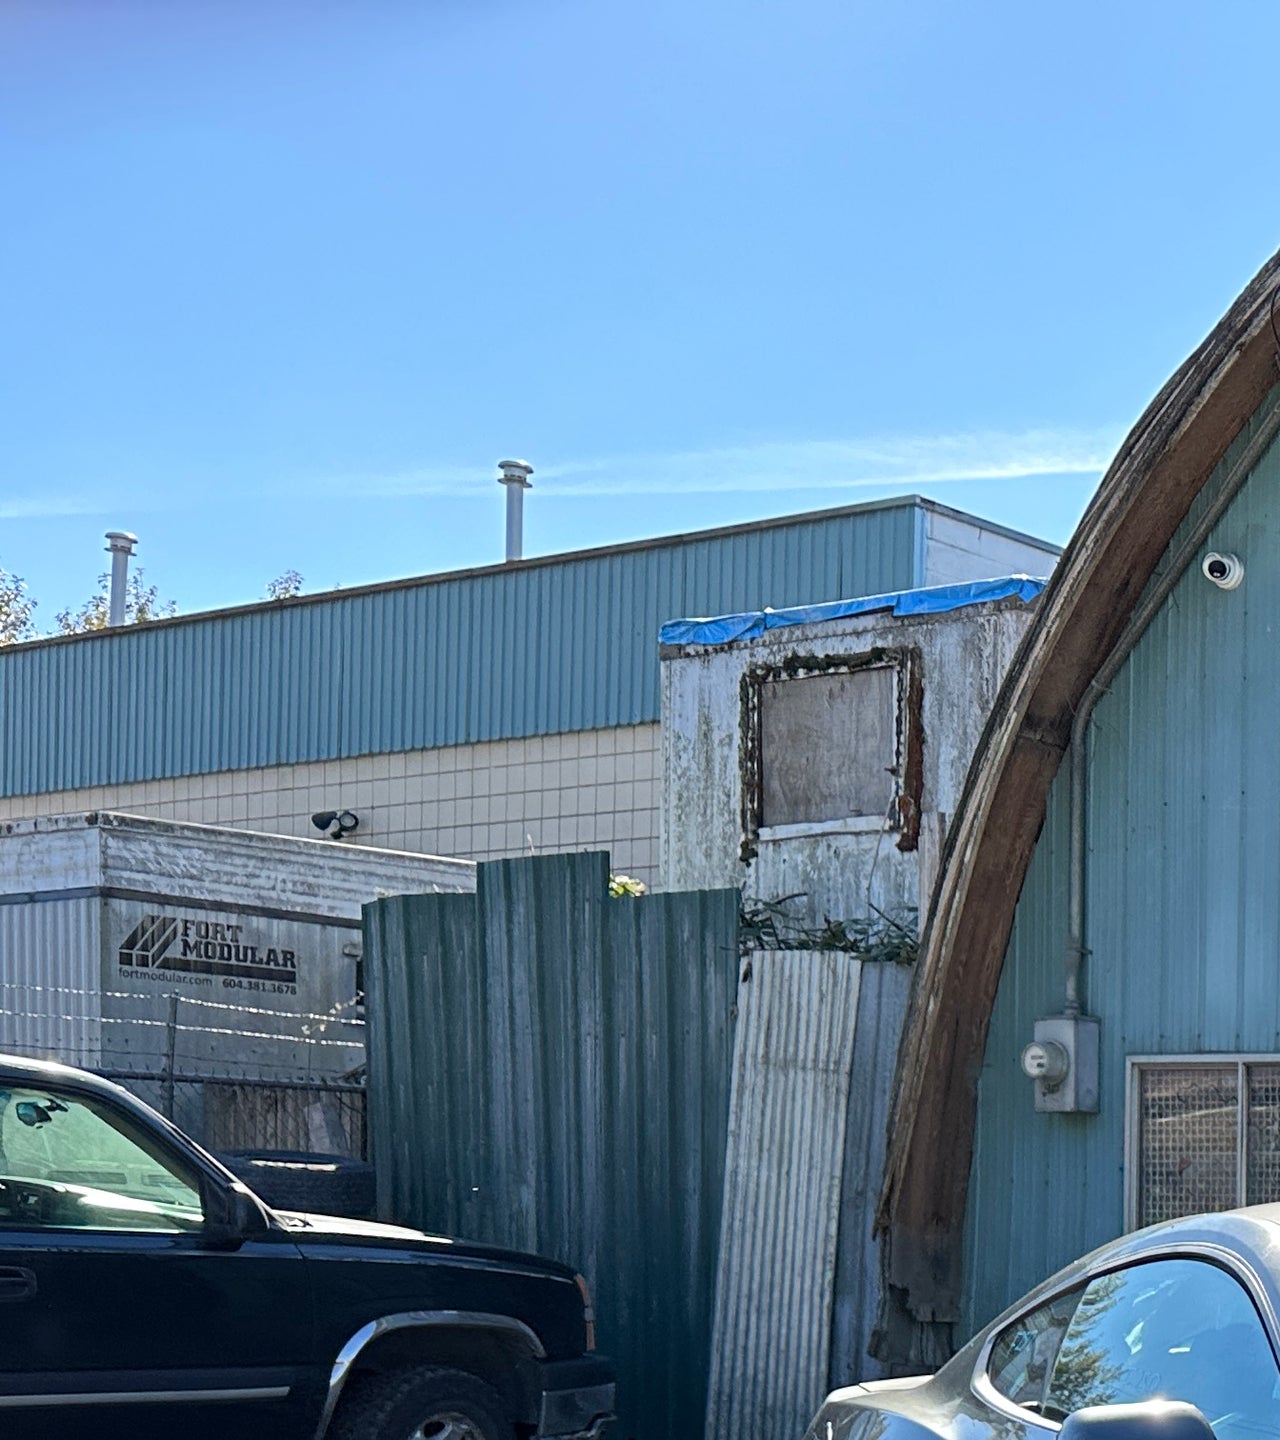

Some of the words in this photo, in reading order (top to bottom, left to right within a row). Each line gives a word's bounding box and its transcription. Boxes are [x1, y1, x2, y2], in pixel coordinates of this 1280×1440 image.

[180, 919, 243, 943] FORT
[180, 939, 297, 969] MODULAR
[118, 967, 213, 987] fortmodular.com
[222, 978, 297, 995] 604.381.3678
